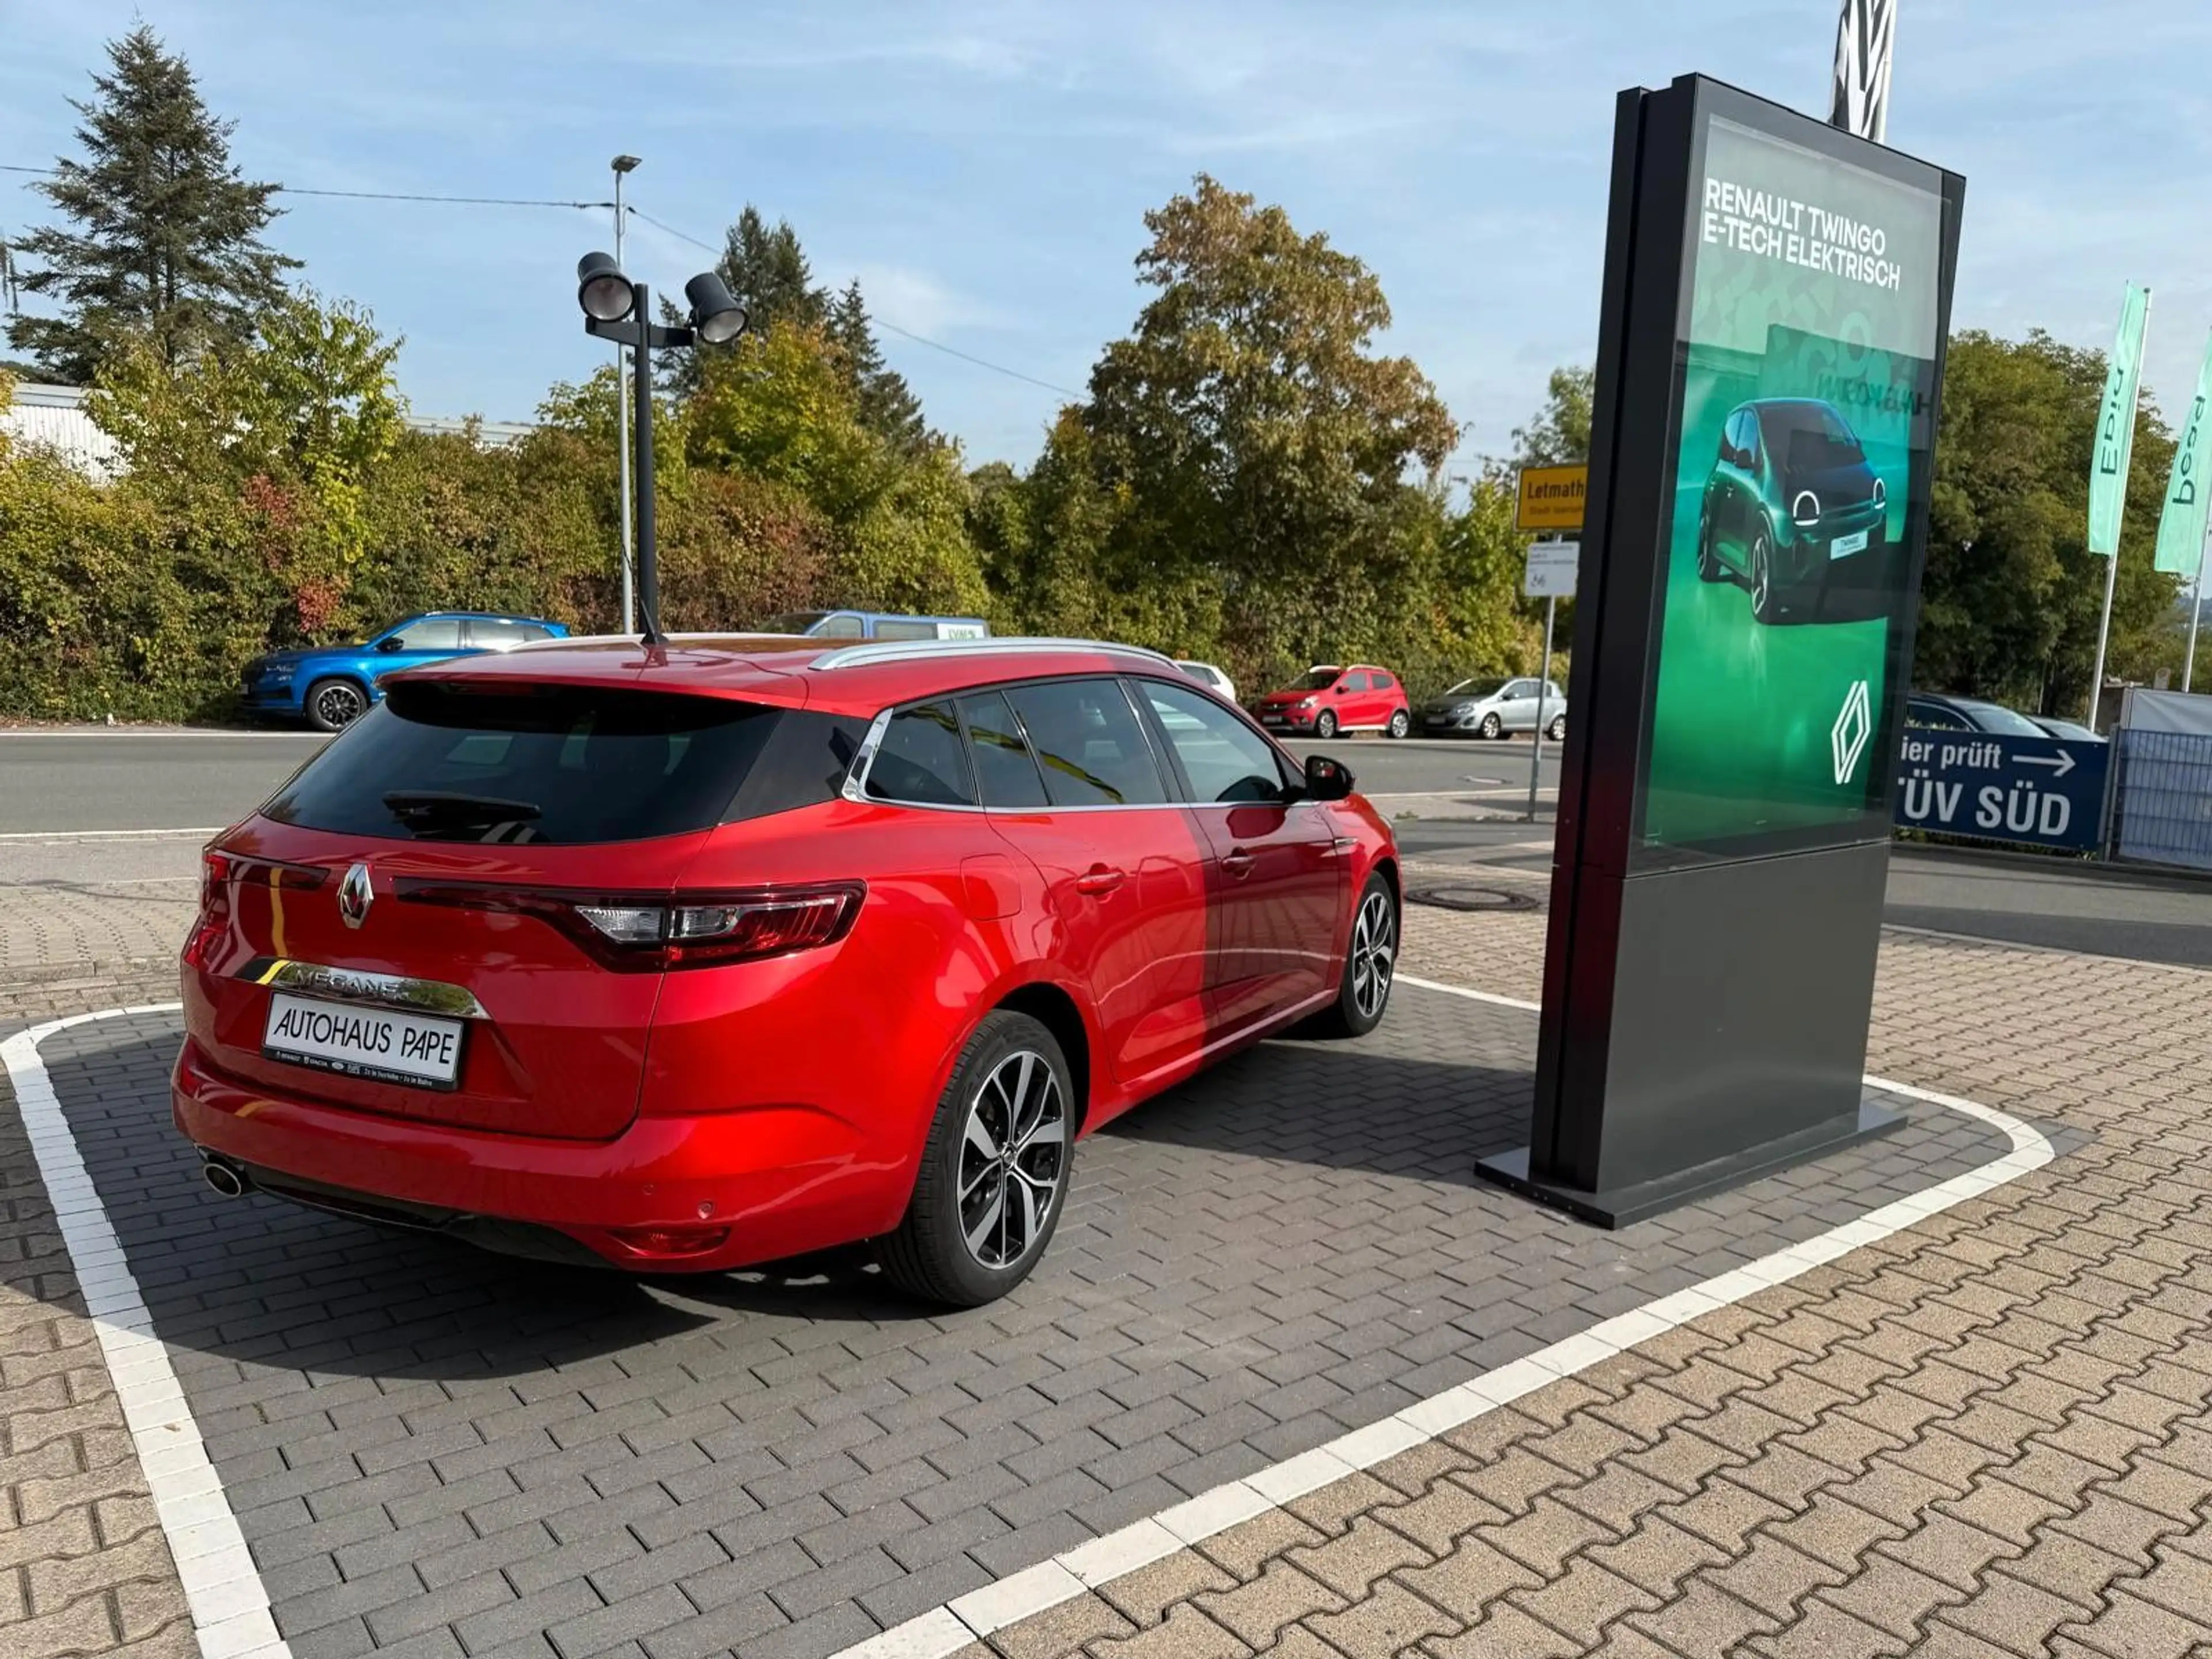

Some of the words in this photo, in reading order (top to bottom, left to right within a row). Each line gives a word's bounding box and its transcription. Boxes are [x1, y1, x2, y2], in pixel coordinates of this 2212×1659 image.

[1705, 177, 1805, 232] RENAULT
[1808, 207, 1885, 256] TWINGO
[1703, 211, 1782, 259] E-TECH
[1786, 234, 1900, 291] ELEKTRISCH
[1528, 479, 1584, 499] Letmath
[1901, 737, 1935, 762] ier
[1941, 742, 2002, 770] prüft
[1898, 769, 1963, 823] ÜV
[1975, 779, 2072, 836] SÜD
[295, 969, 400, 994] MEGANE
[274, 1008, 392, 1054] AUTOHAUS
[401, 1028, 454, 1065] PAPE
